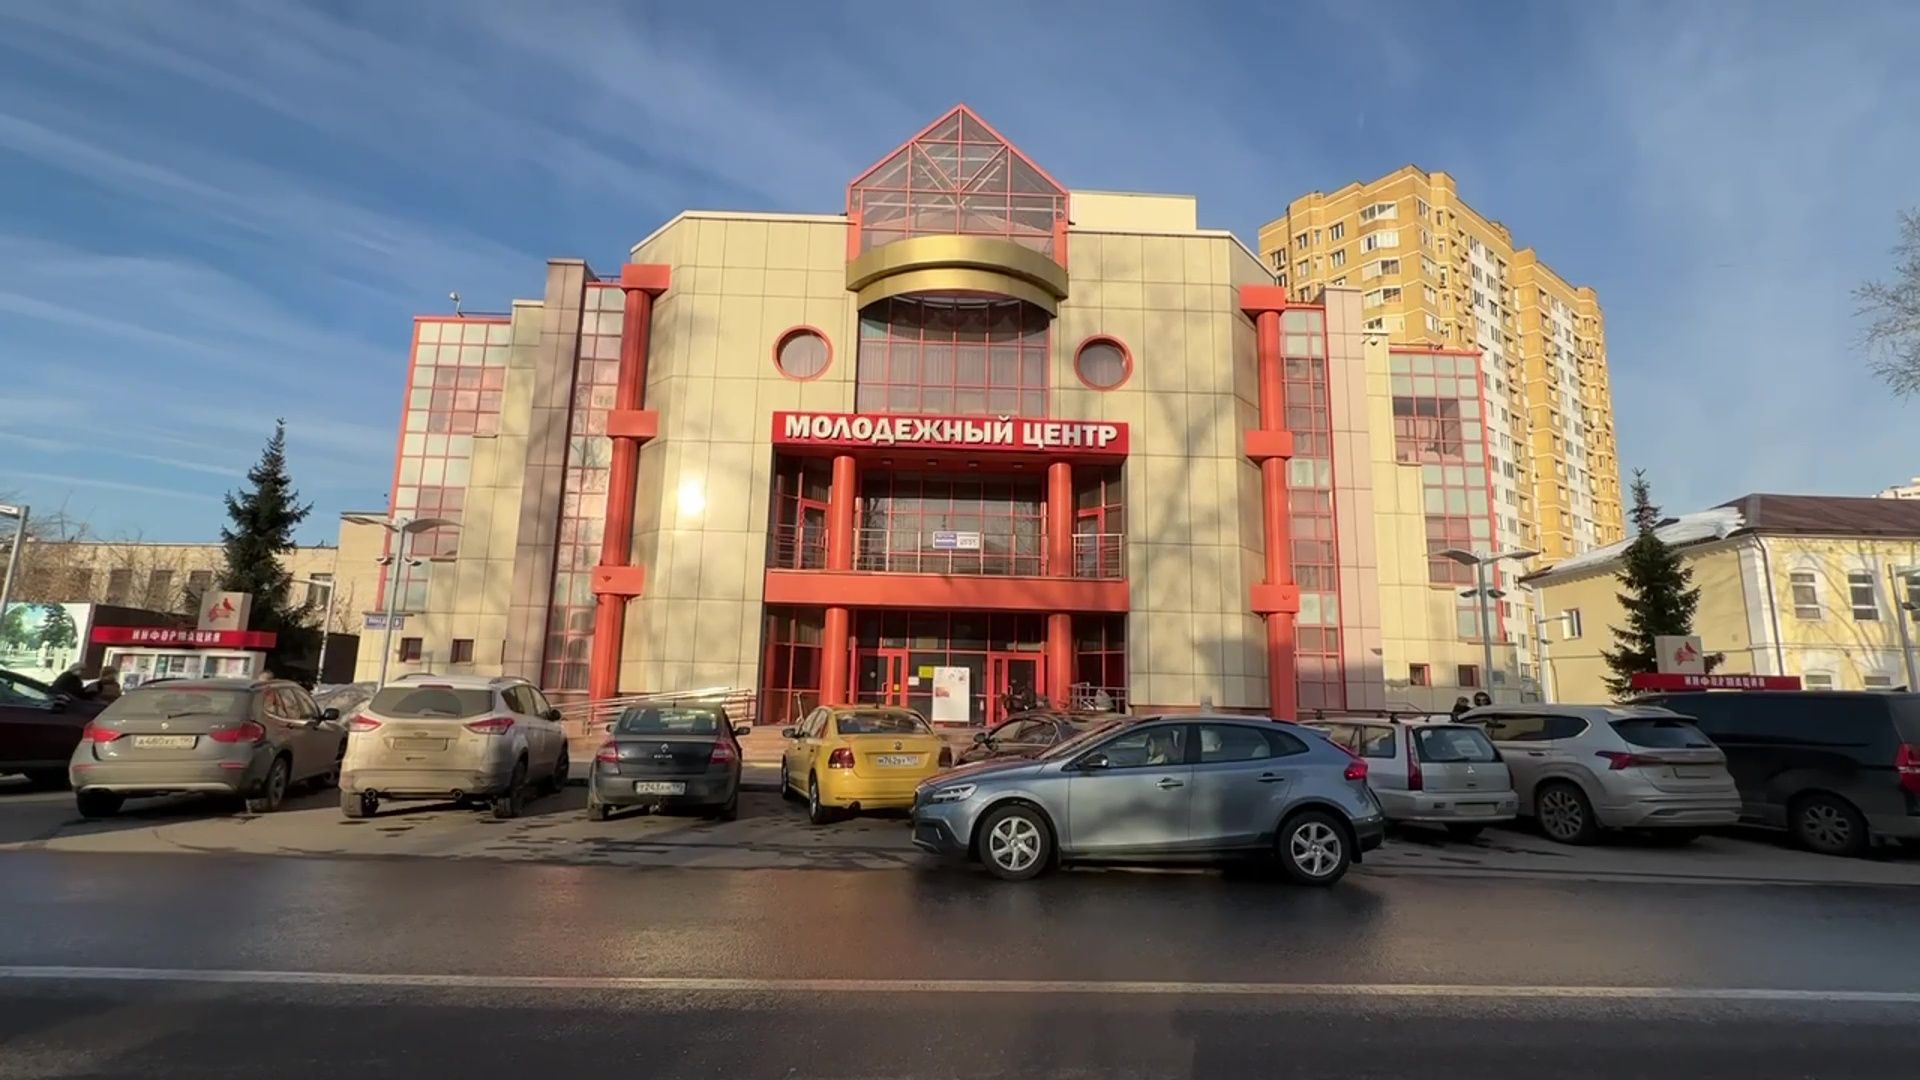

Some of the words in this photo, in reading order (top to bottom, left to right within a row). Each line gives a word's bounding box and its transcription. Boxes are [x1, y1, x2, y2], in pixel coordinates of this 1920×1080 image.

[784, 414, 1014, 445] МОЛОДЕЖНЫЙ
[1022, 423, 1118, 449] ЦЕНТР
[132, 629, 221, 642] ИНФОРМАЦИЯ
[1684, 675, 1766, 688] ИНФОРМАЦИЯ
